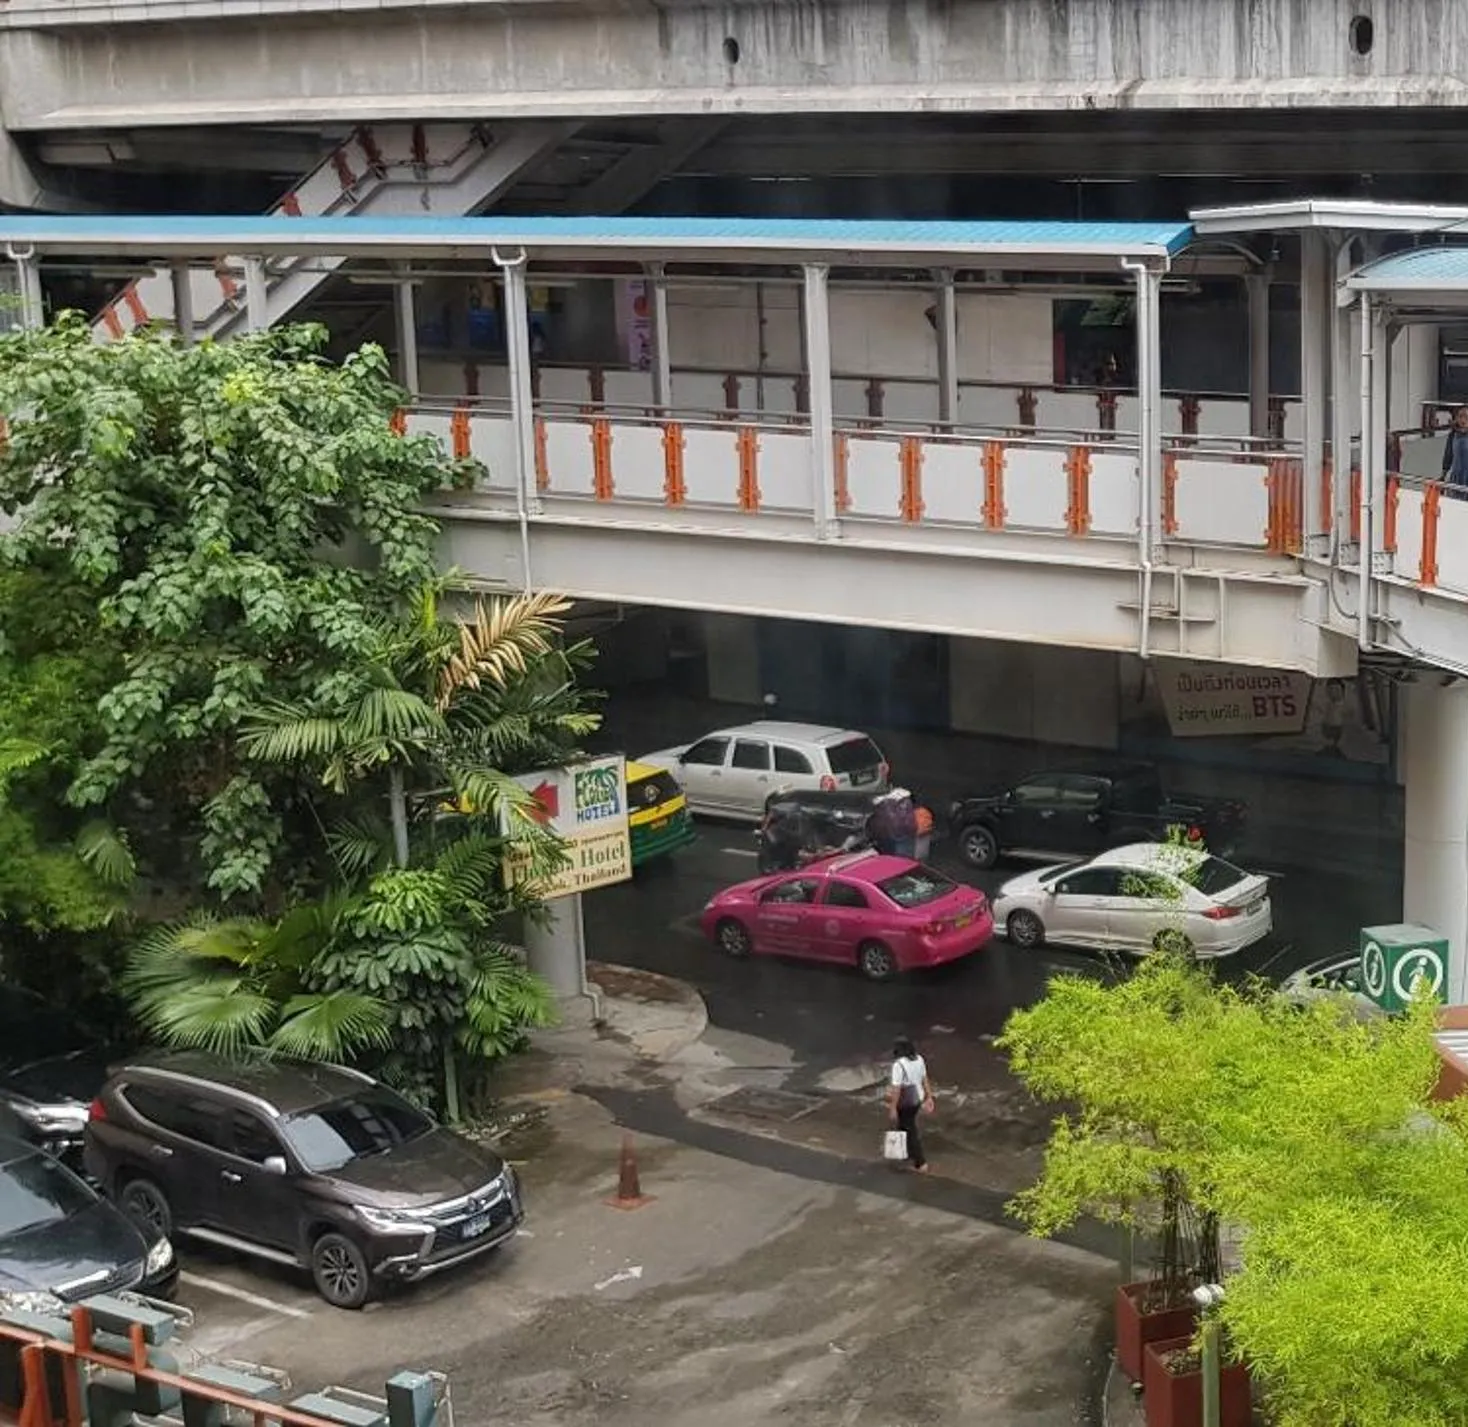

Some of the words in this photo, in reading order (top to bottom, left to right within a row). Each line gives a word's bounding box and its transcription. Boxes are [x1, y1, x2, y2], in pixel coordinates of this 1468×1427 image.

[1253, 695, 1296, 717] BTS
[581, 840, 626, 868] Hotel
[575, 862, 626, 886] Thailand
